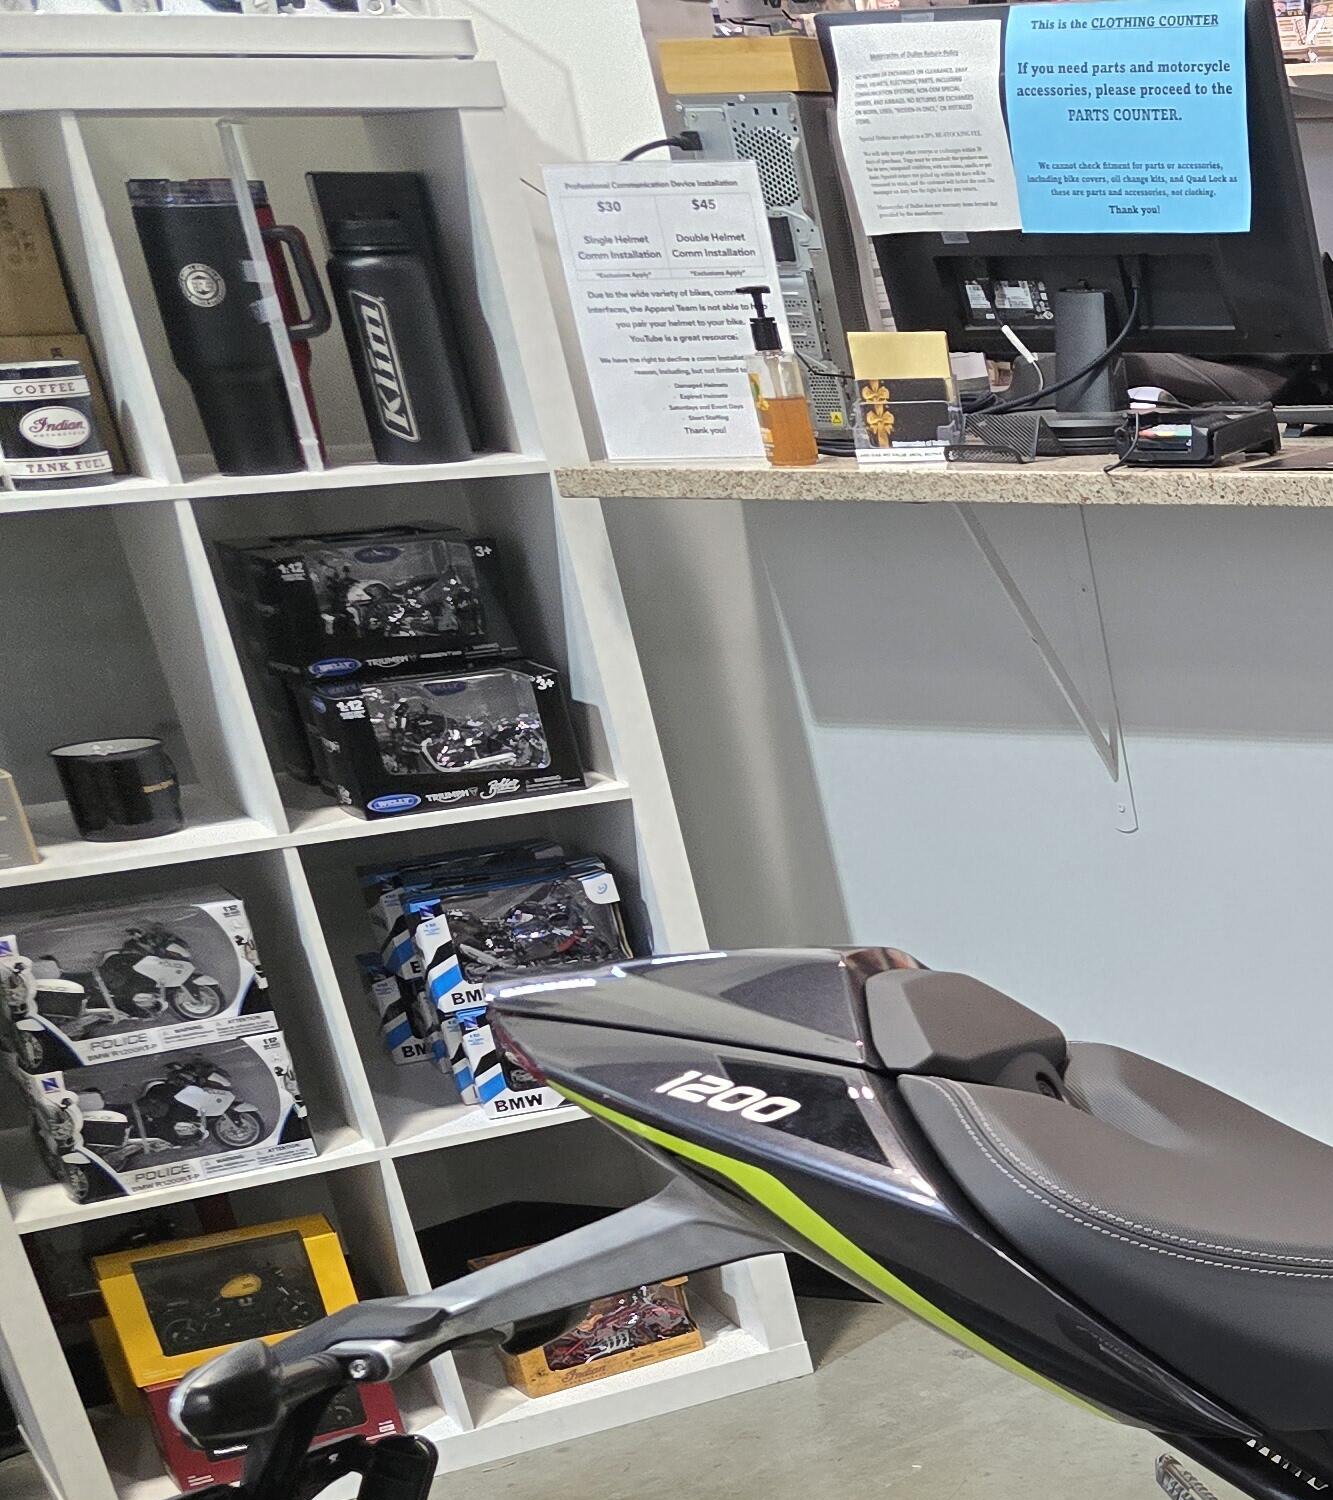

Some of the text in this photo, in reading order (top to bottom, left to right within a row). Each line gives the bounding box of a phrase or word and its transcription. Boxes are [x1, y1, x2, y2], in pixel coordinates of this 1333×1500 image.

[1031, 15, 1219, 29] This is the CLOTHING COUNTER
[1018, 60, 1230, 77] If you need parts and motorcycle
[1017, 82, 1233, 99] accessories, please proceed to the
[1068, 108, 1182, 121] PARTS COUNTER.
[597, 199, 716, 212] $30 $45
[1109, 206, 1160, 216] Thank you!
[584, 235, 648, 246] Single Helmet
[676, 234, 709, 242] Double
[578, 251, 662, 260] Comm Installation
[706, 249, 756, 257] Installation
[13, 383, 75, 394] COFFEE
[29, 417, 86, 433] Indian
[26, 459, 105, 473] TANK FUEL
[475, 546, 492, 556] 3+
[366, 656, 409, 667] TRIUMPH
[377, 798, 410, 808] WELLY
[426, 788, 469, 802] TRIUMPH
[451, 990, 484, 1005] BM
[90, 1033, 148, 1050] POLICE
[494, 1093, 543, 1113] BMW
[655, 1070, 801, 1123] 1200
[135, 1164, 191, 1181] POLICE
